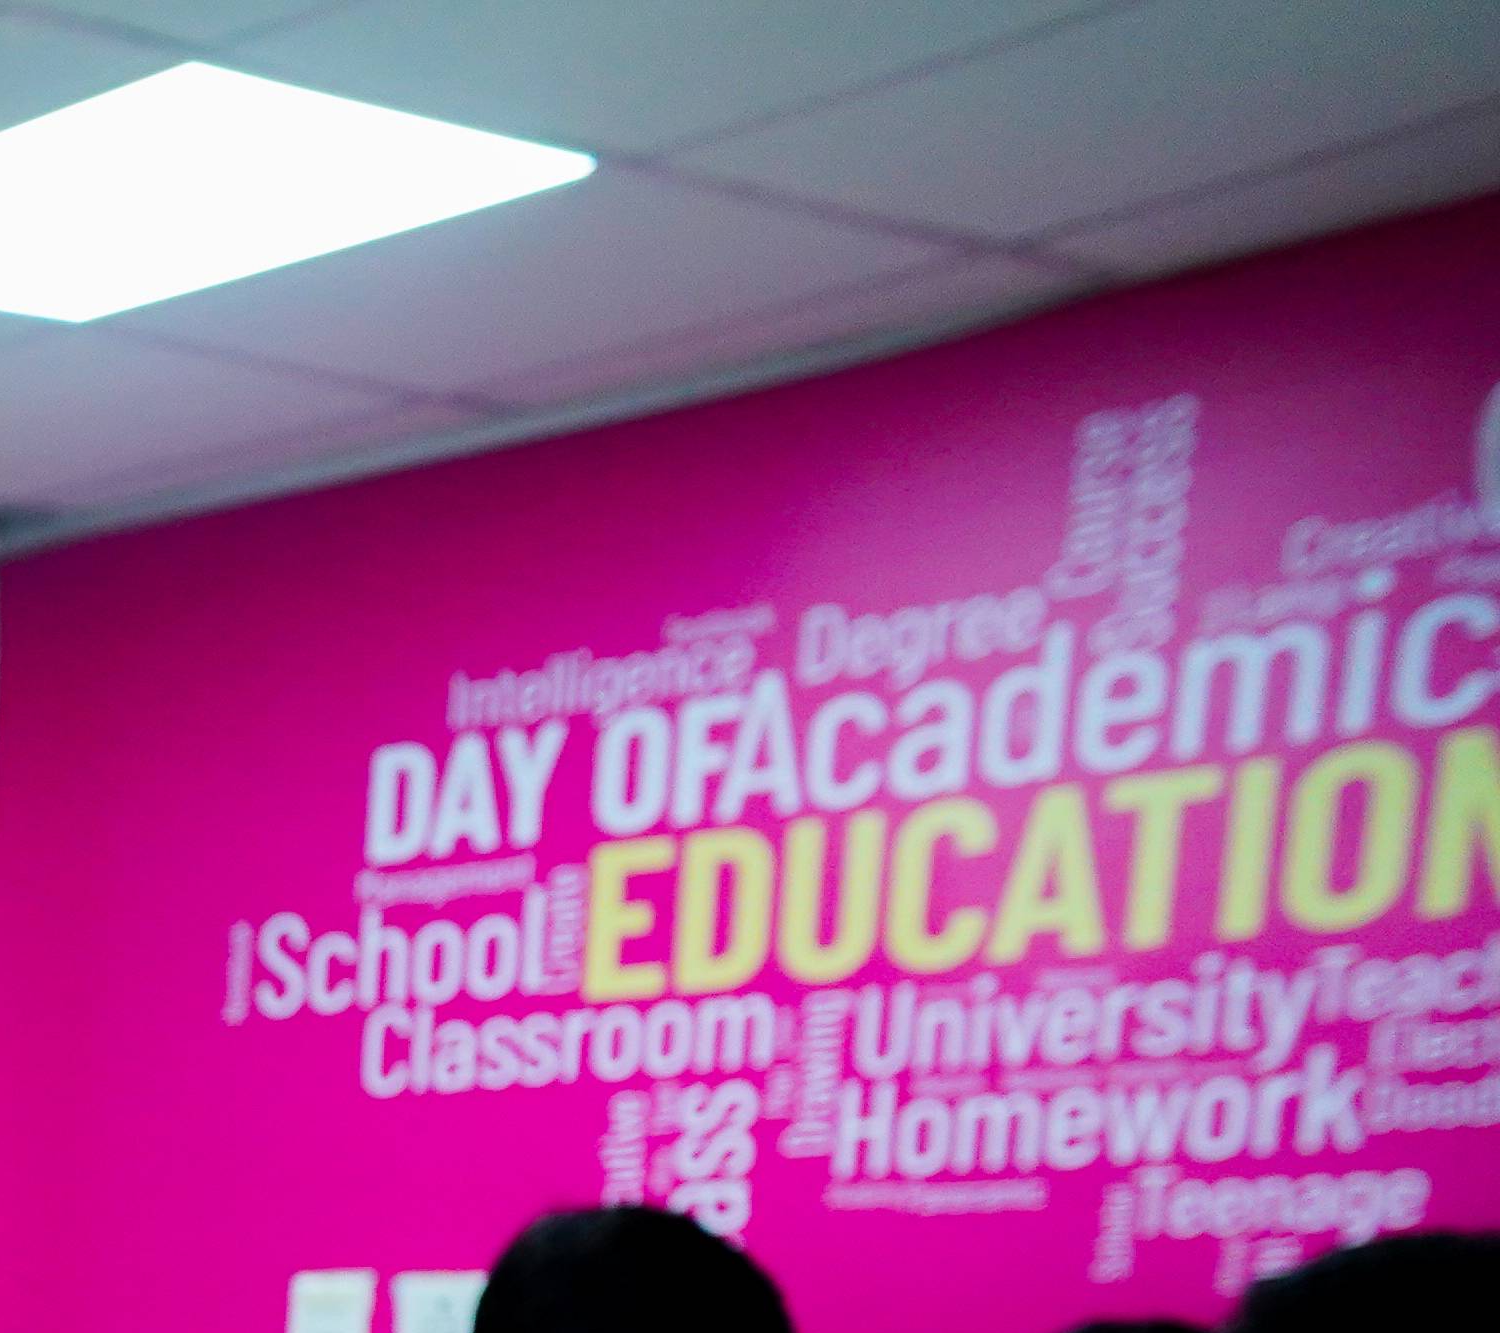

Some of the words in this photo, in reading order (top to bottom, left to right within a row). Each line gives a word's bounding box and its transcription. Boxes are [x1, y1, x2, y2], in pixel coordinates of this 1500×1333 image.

[446, 634, 757, 732] Intelligence
[796, 586, 1049, 688] Degree
[365, 718, 568, 866] DAY
[593, 694, 740, 836] OF
[583, 722, 1500, 1003] EDUCATION
[255, 880, 549, 1018] School
[360, 990, 774, 1099] Classroom
[850, 950, 1315, 1080] University
[828, 1042, 1370, 1182] Homework
[1132, 1162, 1433, 1250] Teenage
